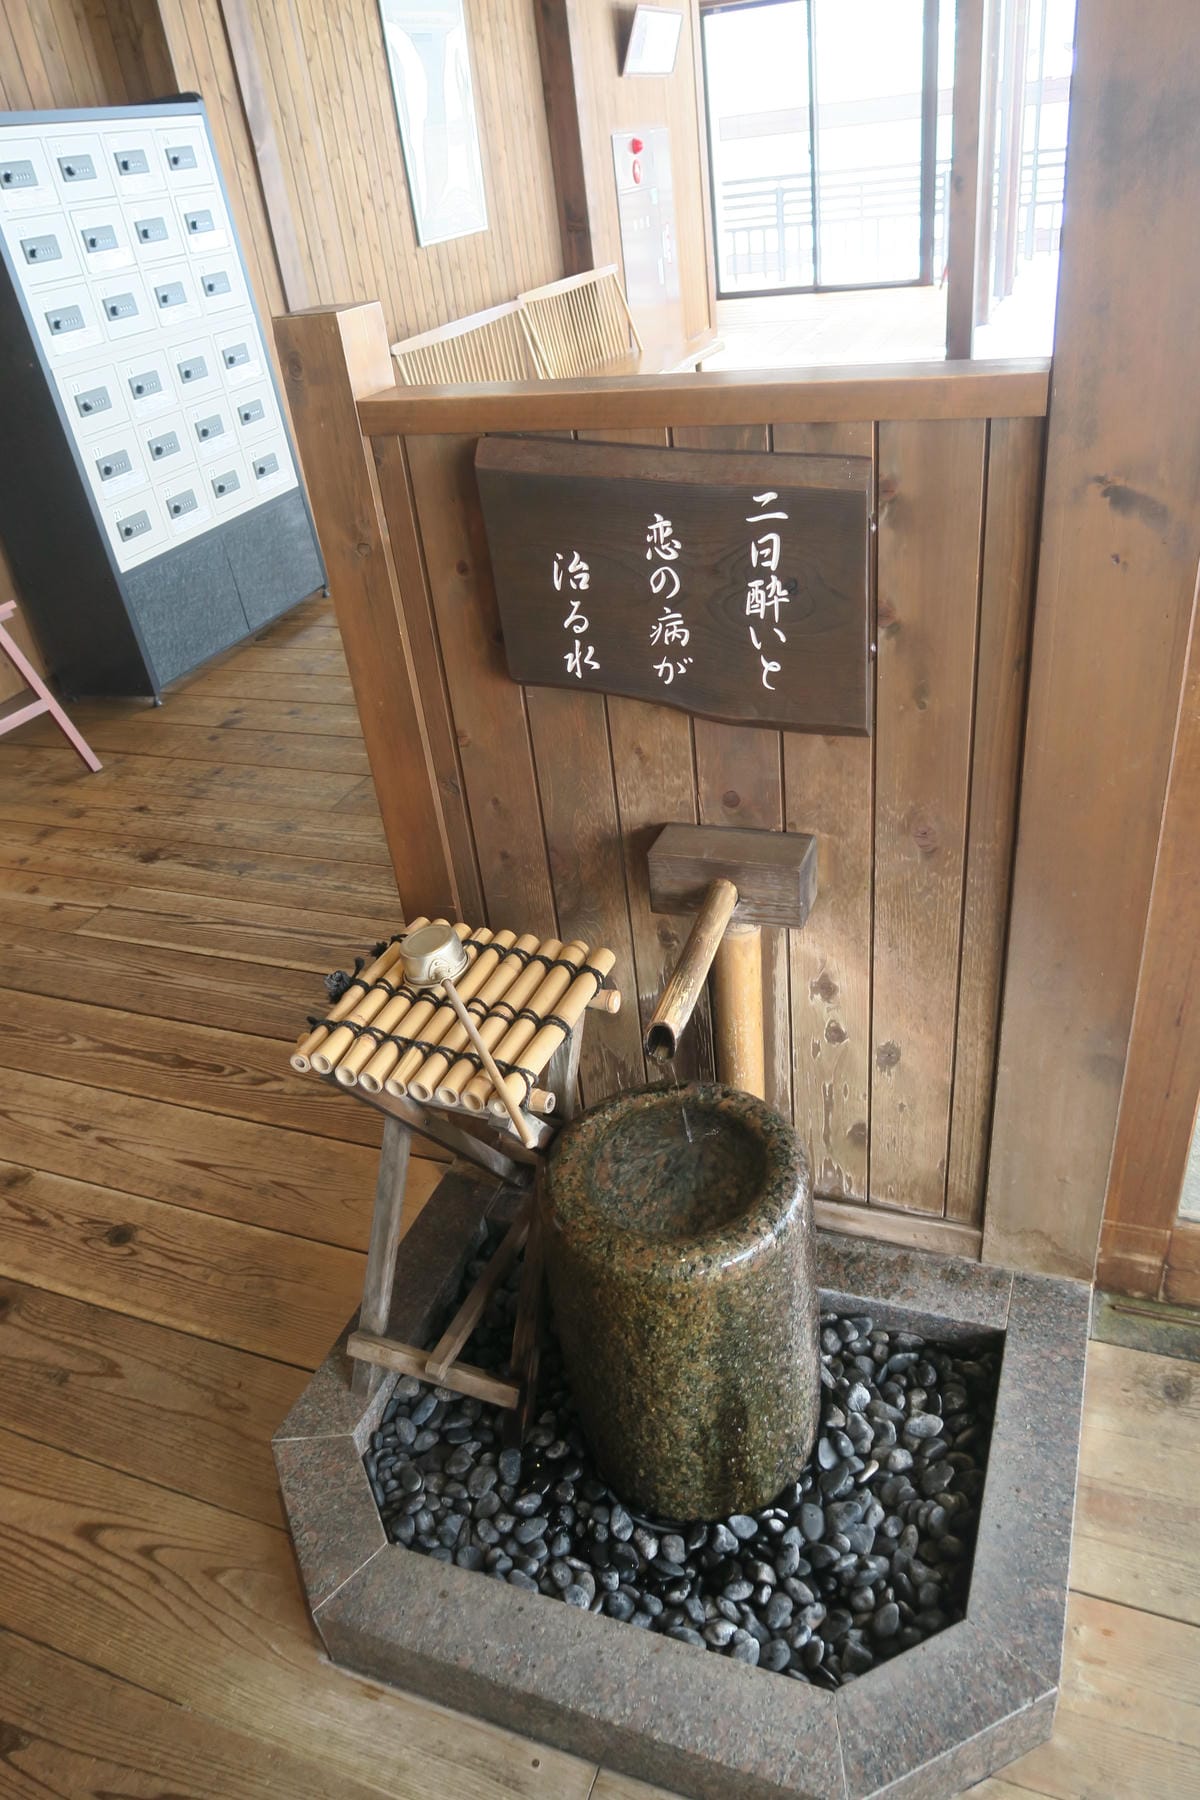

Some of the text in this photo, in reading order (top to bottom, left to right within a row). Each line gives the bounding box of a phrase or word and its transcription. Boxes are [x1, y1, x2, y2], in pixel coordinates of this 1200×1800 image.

[553, 550, 600, 679] 治る水
[645, 513, 693, 684] 恋の病が
[745, 491, 790, 690] 二日酔いと
